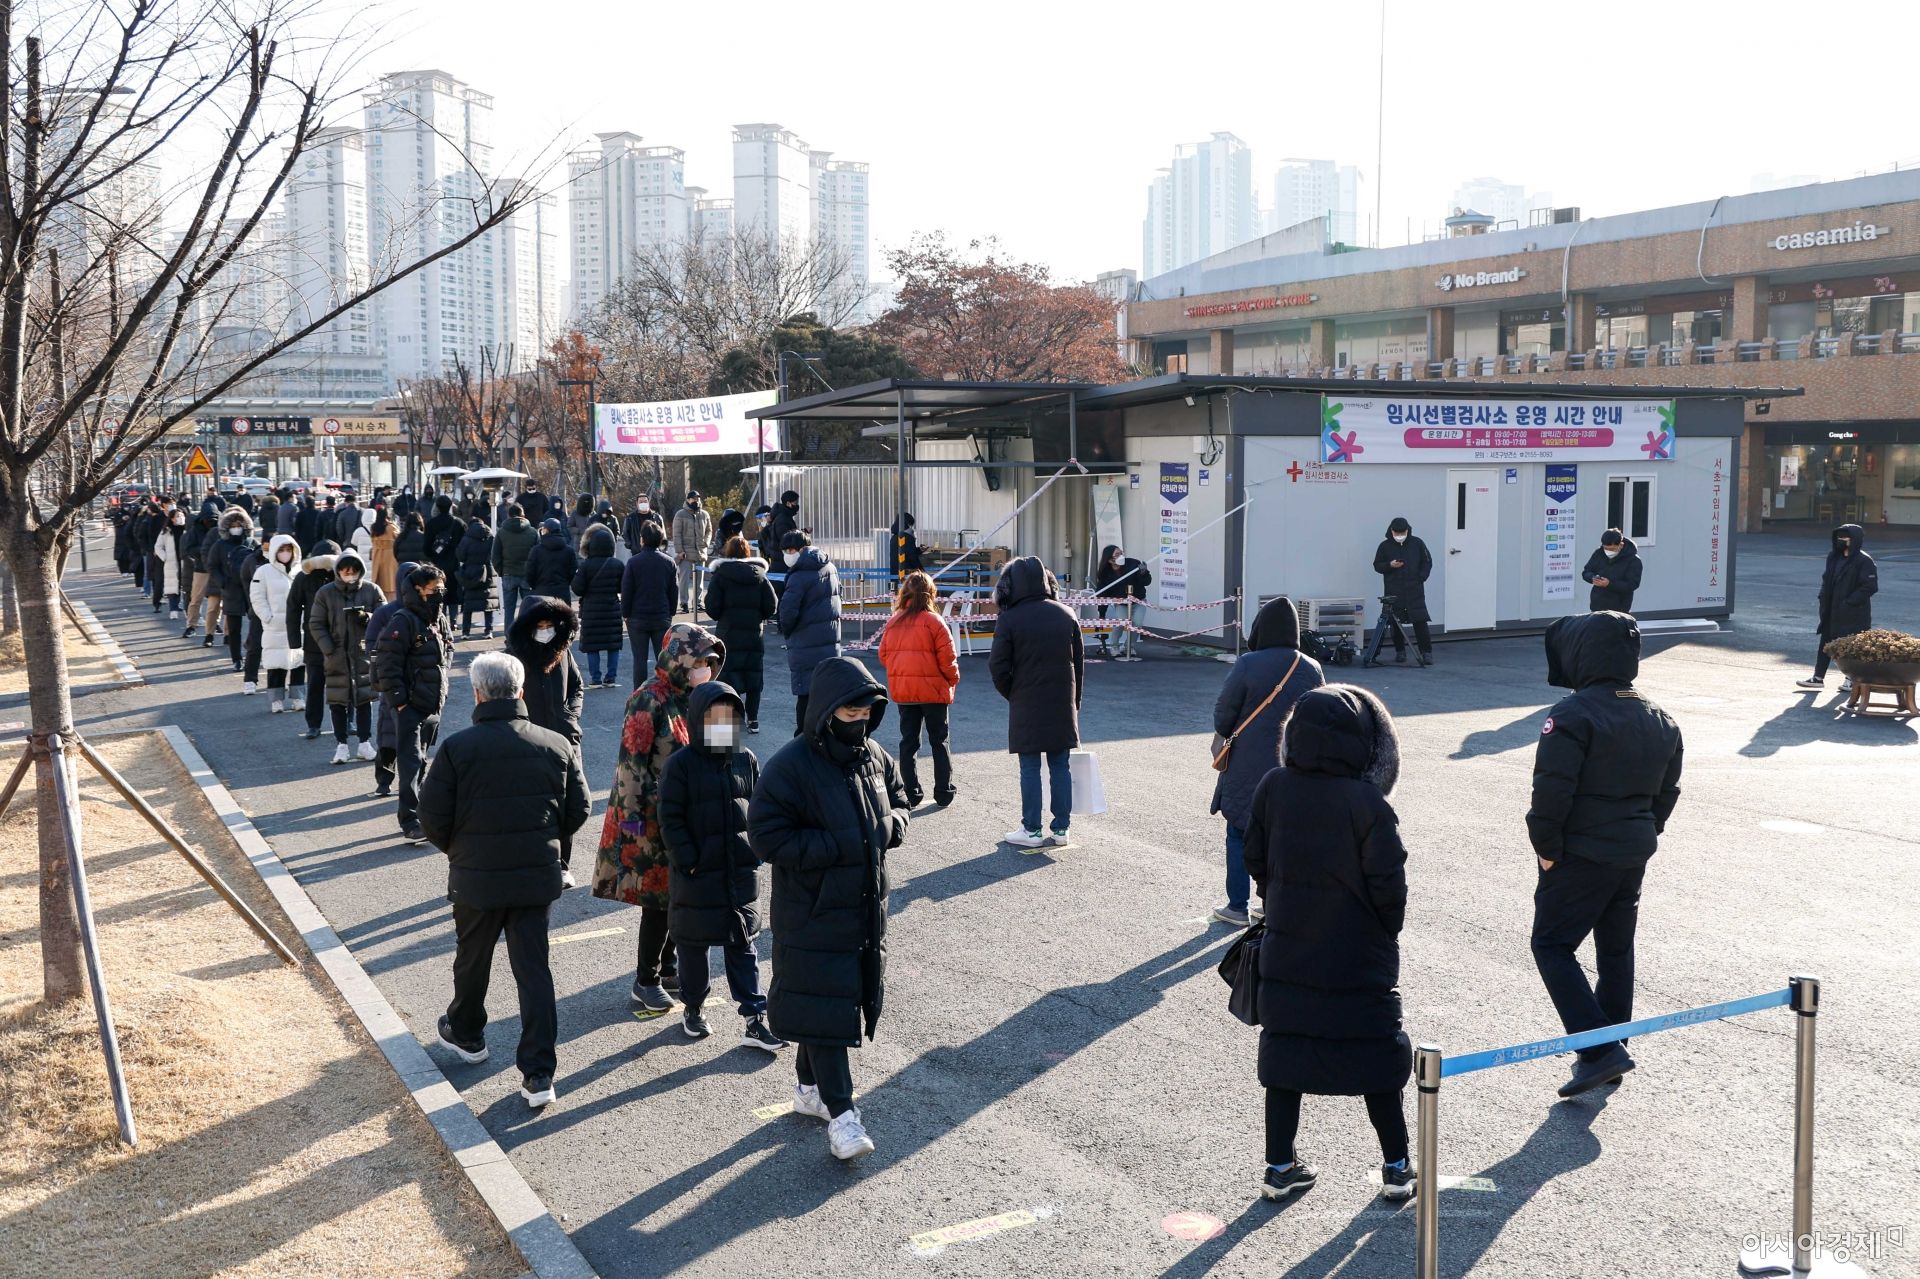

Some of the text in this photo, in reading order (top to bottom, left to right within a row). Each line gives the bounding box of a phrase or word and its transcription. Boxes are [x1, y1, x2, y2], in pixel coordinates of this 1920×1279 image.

[1775, 220, 1878, 251] casamia
[1455, 266, 1519, 288] No Brand
[1187, 292, 1313, 318] SHINSEGAE FACTORY STORE
[656, 406, 673, 424] 운영
[677, 404, 696, 422] 시간
[699, 401, 724, 421] 안내
[1386, 403, 1623, 426] 임시선별검사소 운영 시간 안내
[253, 421, 299, 432] 모범택시
[343, 421, 387, 432] 택시승차
[1828, 431, 1843, 439] Gong
[1304, 471, 1349, 480] 임시선별검사소
